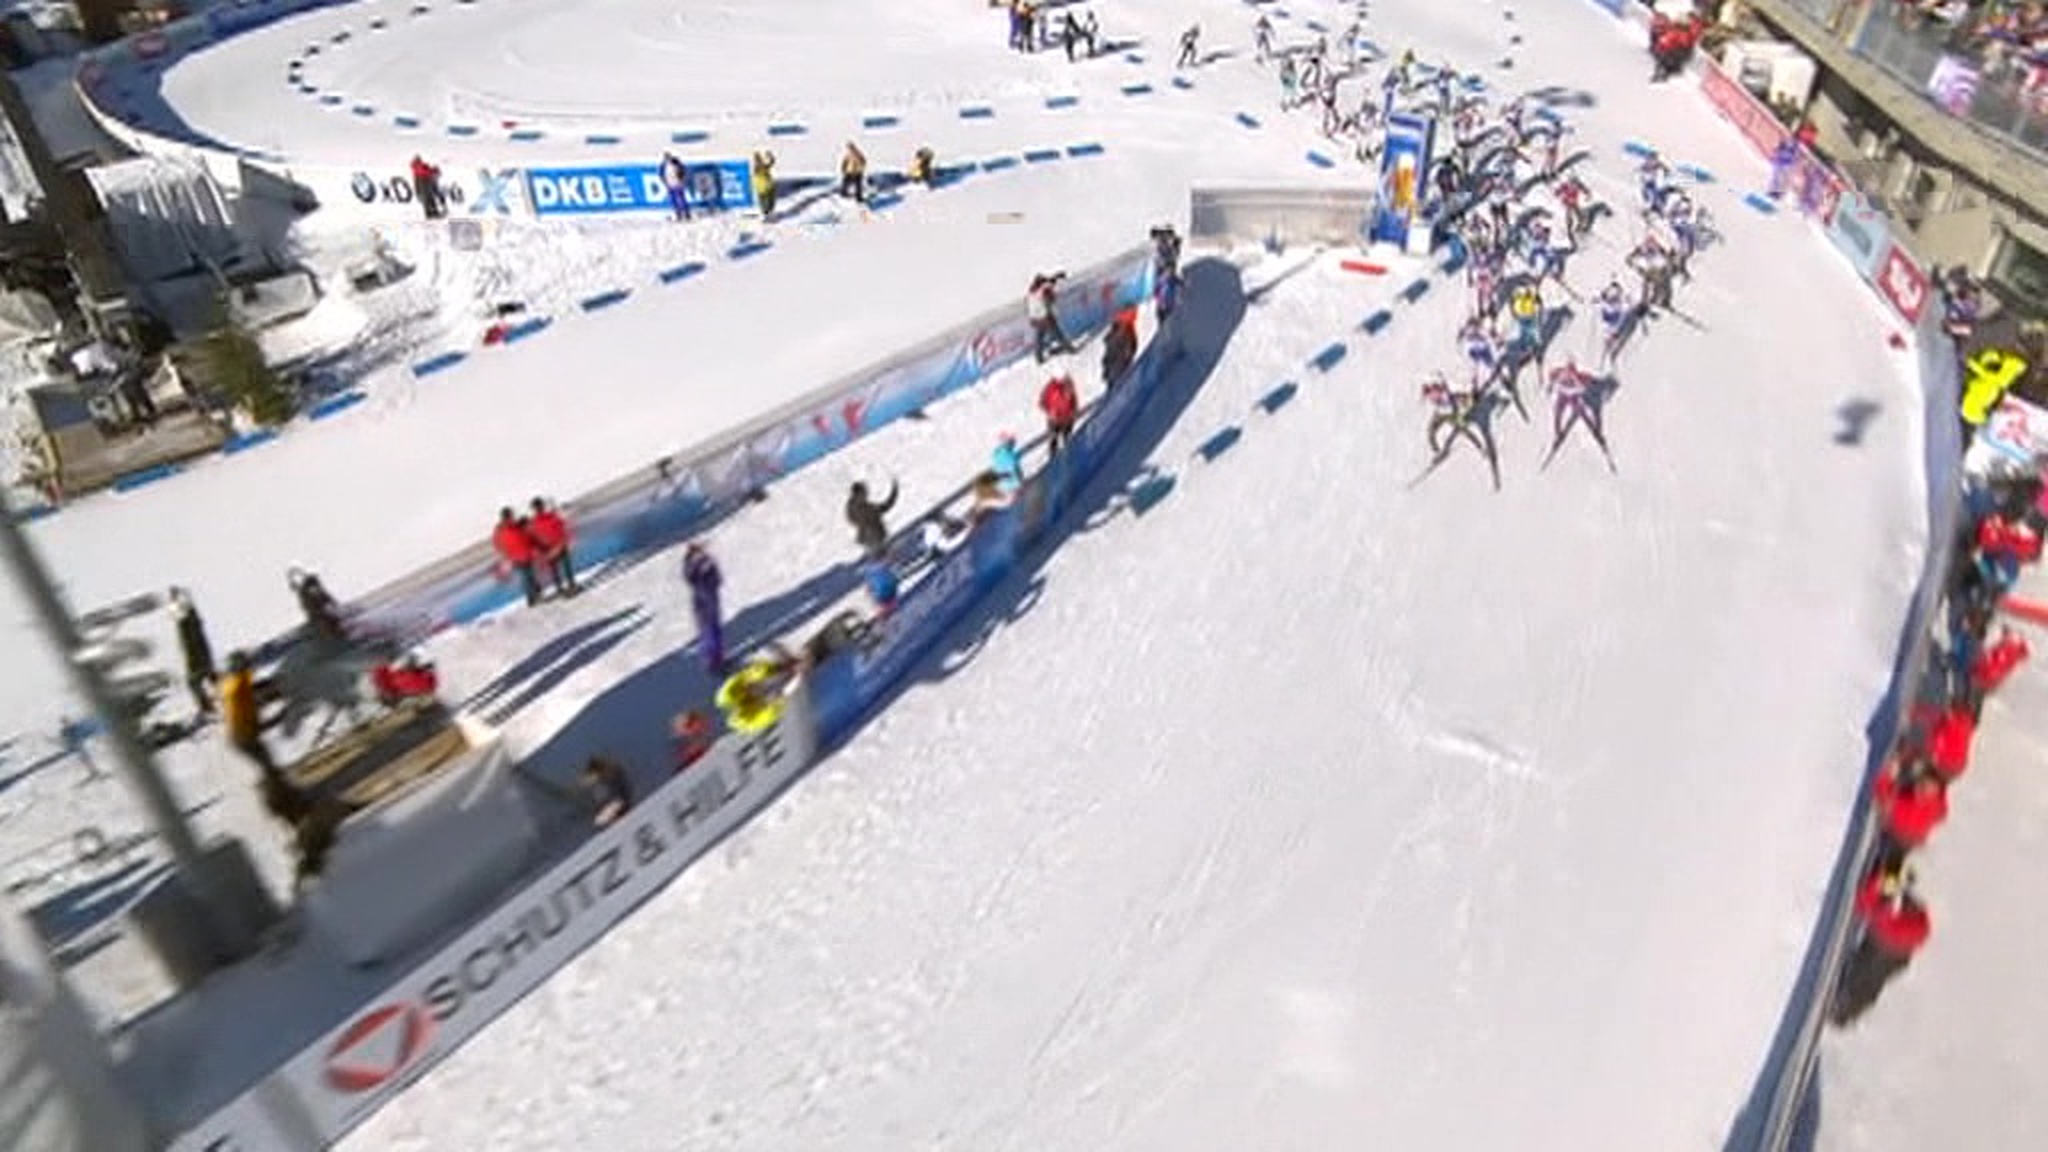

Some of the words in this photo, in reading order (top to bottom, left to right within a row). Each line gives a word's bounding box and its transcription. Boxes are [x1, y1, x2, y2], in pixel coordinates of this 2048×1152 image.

[534, 175, 606, 207] DKB
[422, 846, 631, 1021] SCHUTZ
[634, 823, 668, 868] &
[667, 728, 785, 839] HILFE
